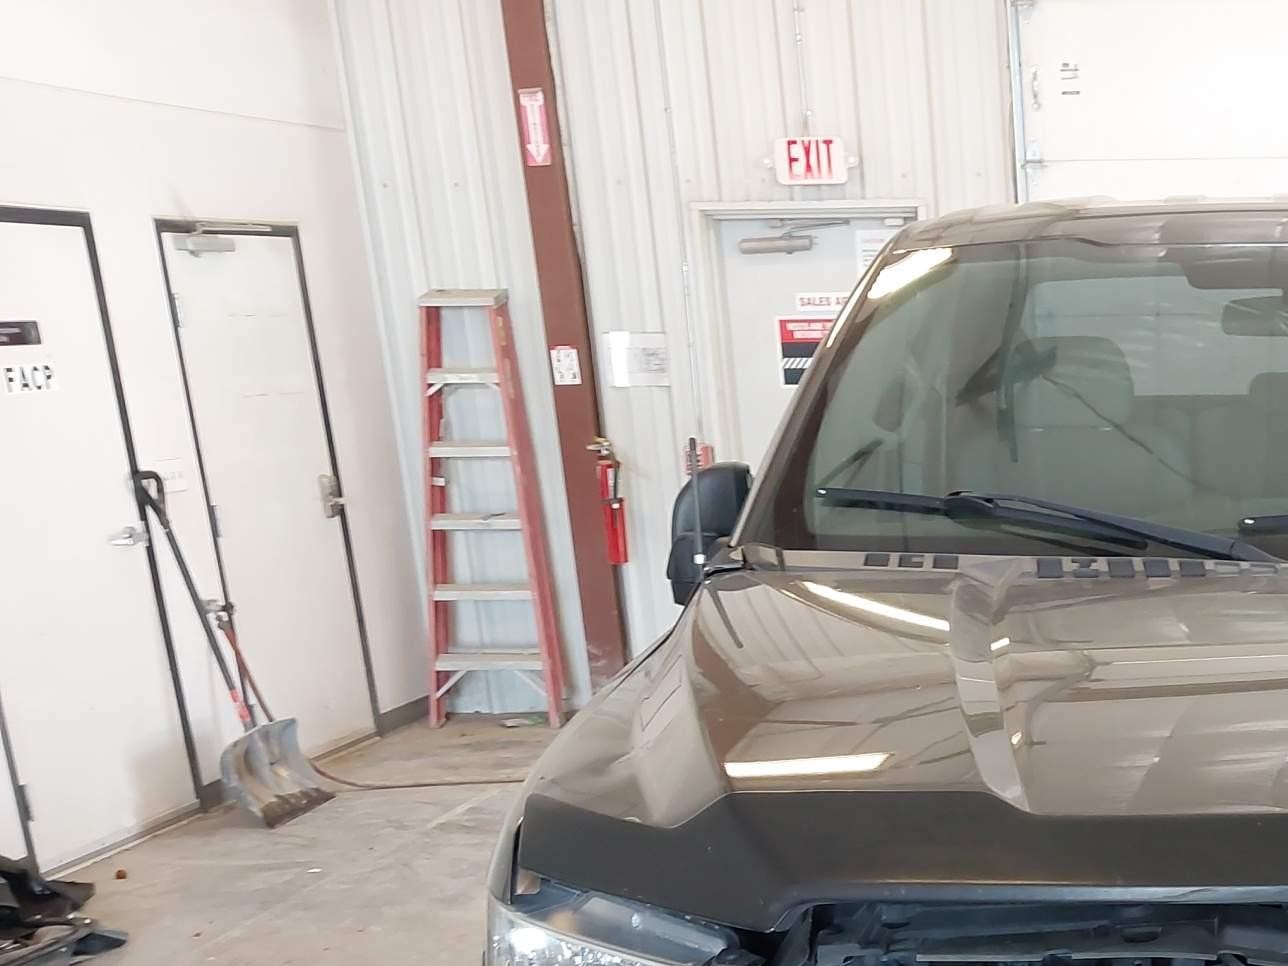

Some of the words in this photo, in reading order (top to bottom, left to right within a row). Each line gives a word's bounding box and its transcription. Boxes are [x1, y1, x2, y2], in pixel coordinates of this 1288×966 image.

[786, 139, 834, 180] EXIT
[799, 296, 831, 307] SALES
[3, 365, 54, 393] FACP
